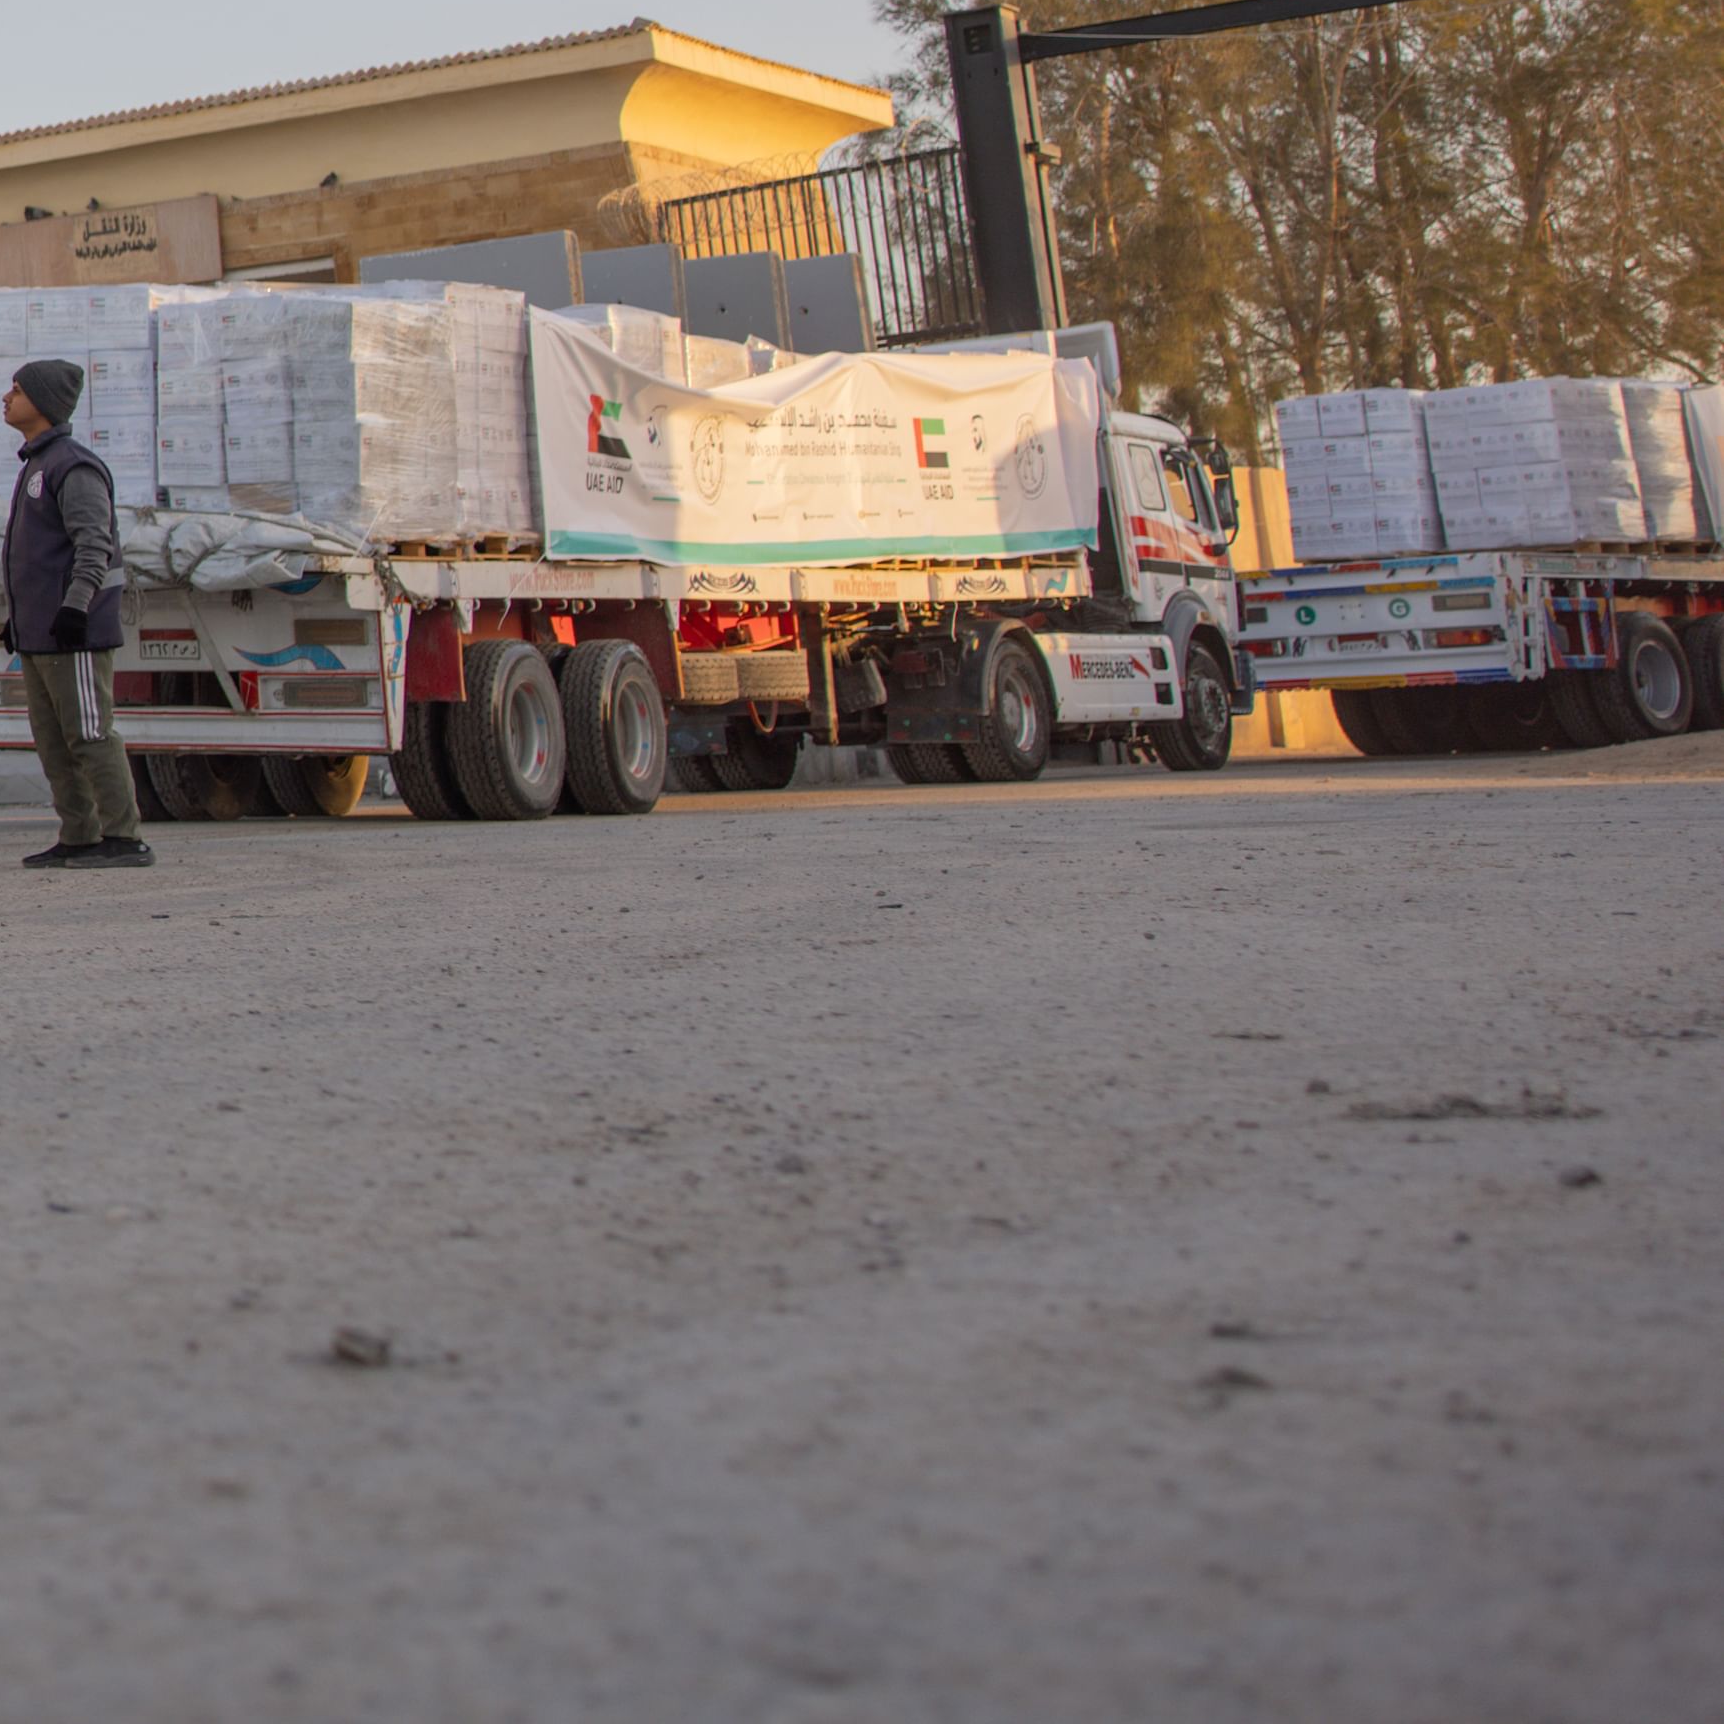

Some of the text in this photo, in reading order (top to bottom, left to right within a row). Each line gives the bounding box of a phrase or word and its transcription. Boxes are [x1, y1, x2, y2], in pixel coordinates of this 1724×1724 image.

[586, 472, 624, 494] UAE AID
[941, 484, 954, 500] AID
